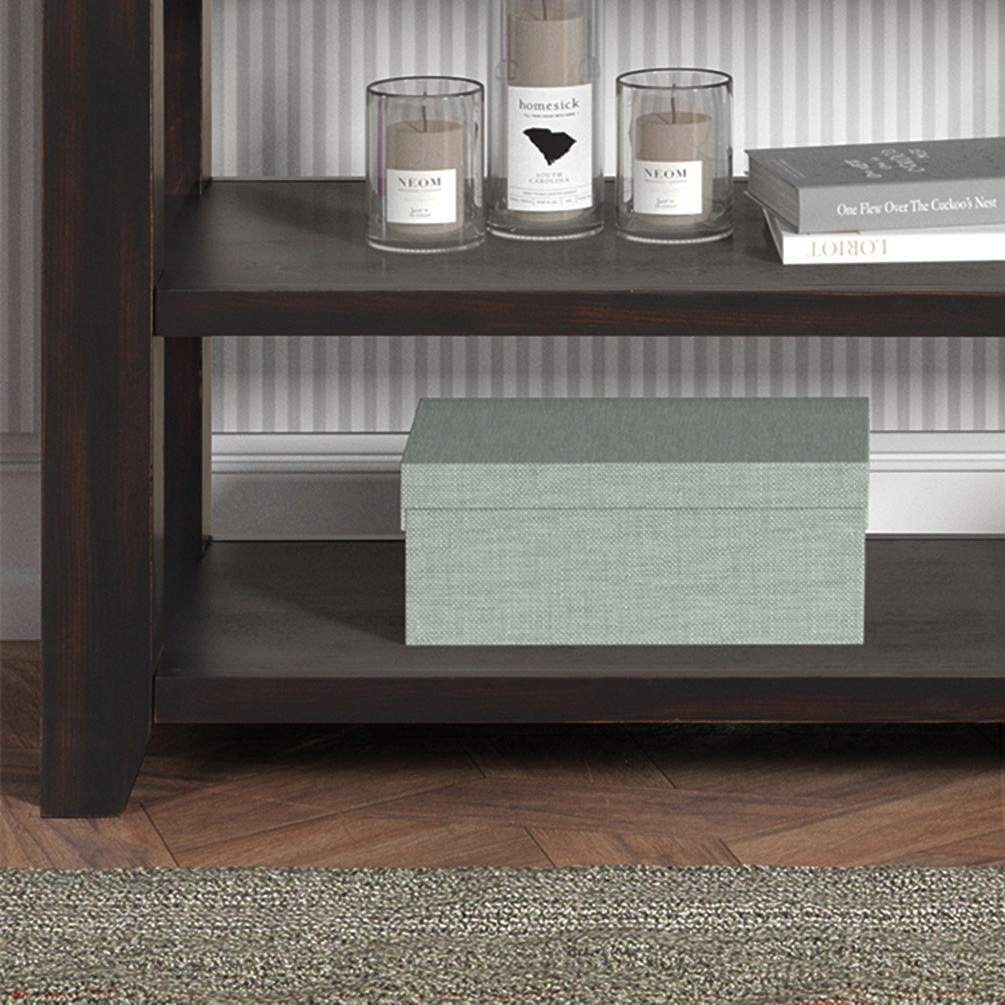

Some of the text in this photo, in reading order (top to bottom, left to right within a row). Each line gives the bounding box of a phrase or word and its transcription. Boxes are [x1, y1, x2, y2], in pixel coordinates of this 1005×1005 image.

[518, 98, 580, 111] homesick
[644, 167, 688, 179] NEOM
[397, 176, 442, 188] NEOM
[836, 195, 998, 216] One Flew Over The Cuckoo's Nest
[805, 239, 887, 258] LORIOT
